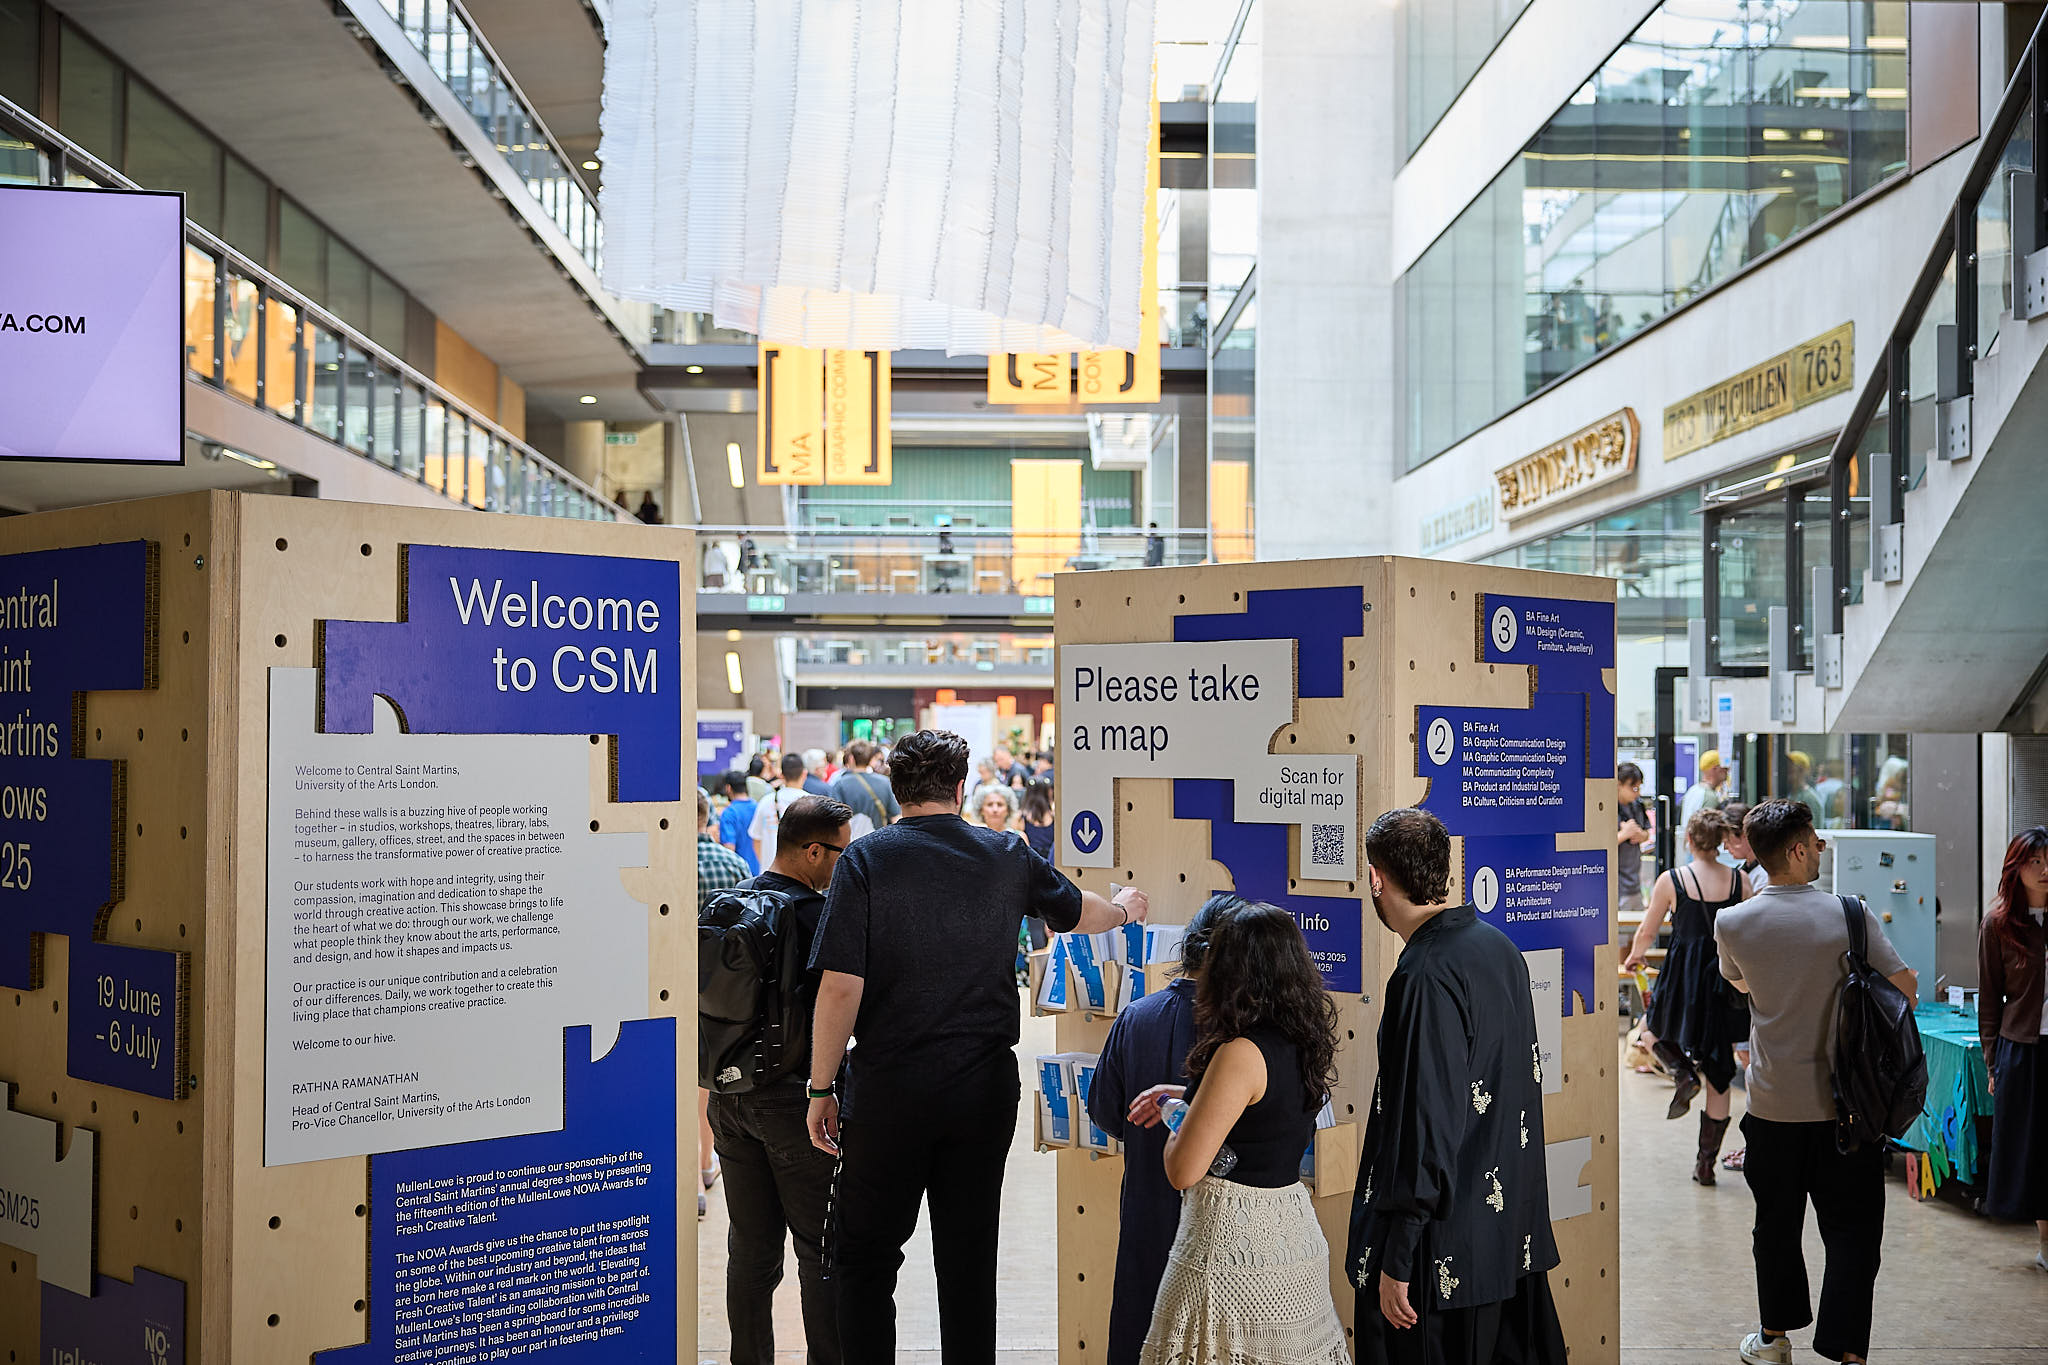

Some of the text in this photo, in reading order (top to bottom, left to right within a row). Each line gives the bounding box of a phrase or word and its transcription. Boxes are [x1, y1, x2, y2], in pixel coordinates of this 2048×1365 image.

[0, 314, 85, 334] A.COM
[1804, 340, 1842, 392] 763
[792, 433, 811, 475] MA
[450, 577, 660, 633] Welcome
[1526, 611, 1559, 623] BA Fine Art
[1498, 614, 1510, 644] 3
[1526, 625, 1584, 639] MA Design (Ceramic,
[1537, 640, 1593, 655] Furniture, Jewellery)
[0, 646, 31, 692] int
[492, 645, 657, 693] to CSM
[1075, 663, 1259, 702] Please take
[1463, 721, 1499, 732] BA Fine Art
[1073, 725, 1168, 761] a map
[1434, 724, 1446, 754] 2
[1463, 737, 1566, 750] BA Graphic Communication Design
[1463, 752, 1566, 765] MA Graphic Communication Design
[295, 764, 459, 775] Welcome to Central Saint Martins,
[1281, 767, 1344, 784] Scan for
[1462, 766, 1554, 779] MA Communicating Complexity
[295, 778, 438, 792] University of the Arts London.
[1462, 781, 1559, 793] BA Product and Industrial Design
[1259, 787, 1343, 810] digital map
[1462, 795, 1562, 807] BA Culture, Criticism and Curation
[1505, 864, 1604, 878] BA Performance Design and Practice
[1482, 875, 1489, 904] 1
[1505, 880, 1561, 893] BA Ceramic Design
[1505, 896, 1551, 907] BA Architecture
[1301, 913, 1329, 931] Info
[1506, 906, 1599, 922] BA Product and Industrial Design
[1327, 952, 1347, 962] 2025
[97, 975, 160, 1016] 19 June
[1531, 980, 1550, 991] Design
[110, 1020, 120, 1053] 6
[126, 1024, 160, 1069] July
[292, 1033, 395, 1050] Welcome to our hive.
[292, 1071, 418, 1094] RATHNA RAMANATHAN
[292, 1093, 439, 1116] Head of Central Saint Martins,
[292, 1095, 530, 1131] Pro-Vice Chancellor, University of the Arts London
[396, 1150, 642, 1193] MullenLowe is proud to continue our sponsorship of the
[396, 1163, 652, 1208] Central Saint Martins’ annual degree shows by presenting
[395, 1177, 647, 1221] the fifteenth edition of the MullenLowe NOVA Awards for
[396, 1212, 497, 1236] Fresh Creative Talent.
